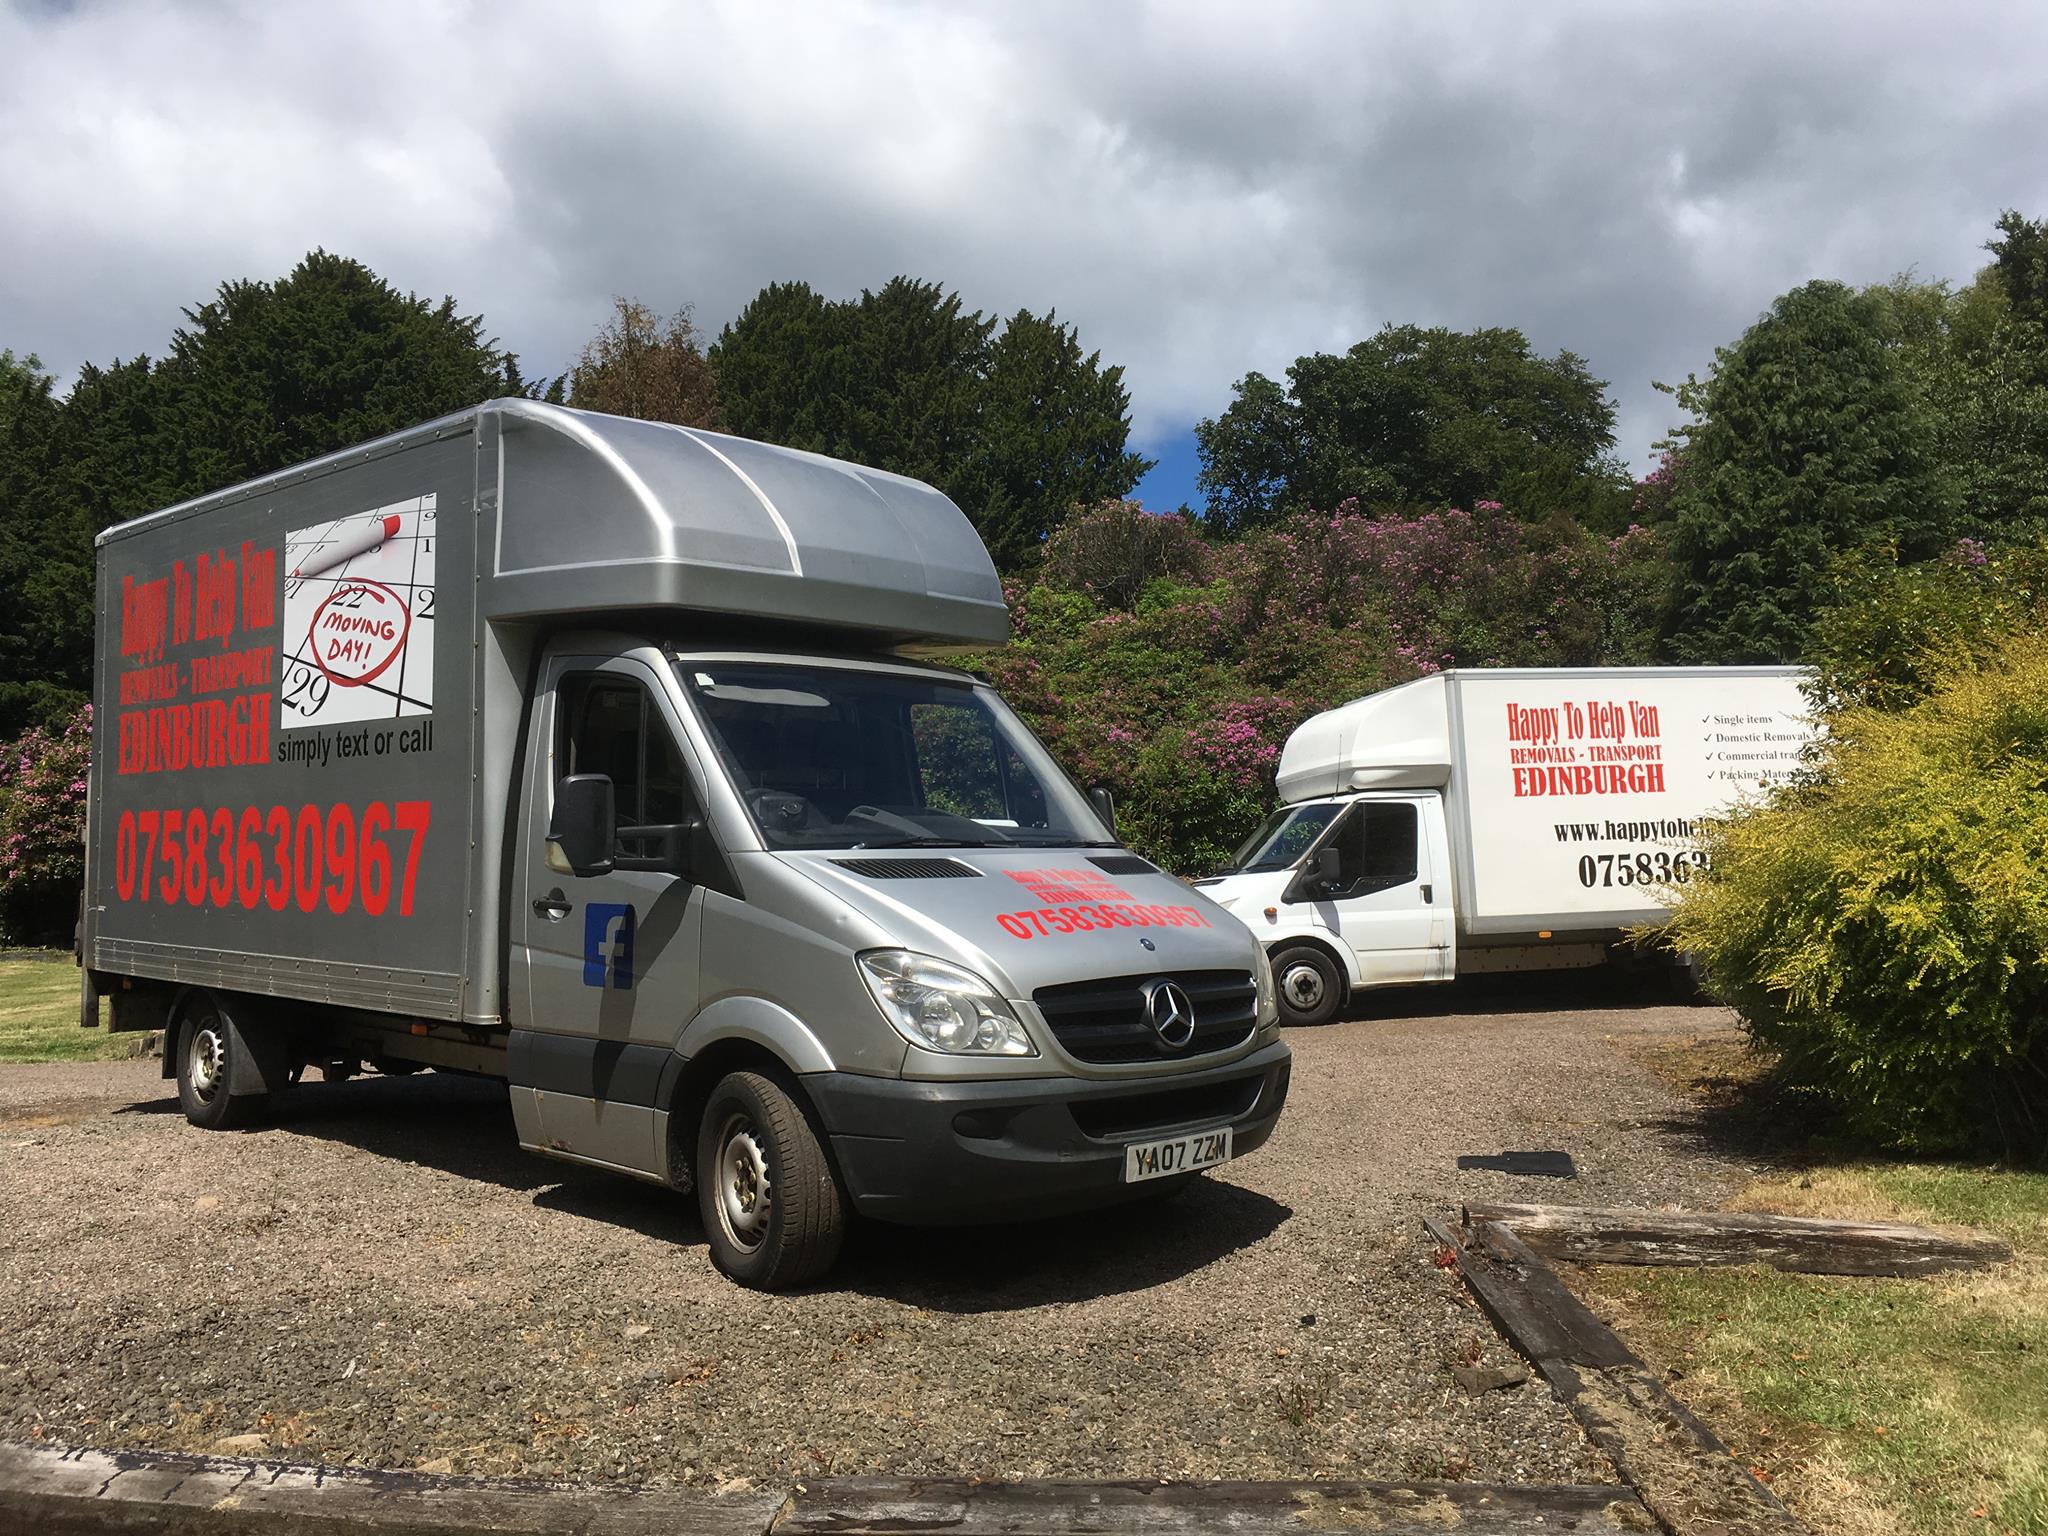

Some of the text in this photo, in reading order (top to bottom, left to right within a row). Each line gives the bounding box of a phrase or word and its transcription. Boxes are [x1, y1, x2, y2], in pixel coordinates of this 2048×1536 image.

[121, 540, 274, 665] Happy To Help Van
[331, 584, 367, 609] 22
[323, 611, 395, 641] MOVING
[327, 638, 372, 670] DAY!
[119, 662, 178, 706] REMOVALS
[191, 645, 273, 695] TRANSPORT
[282, 667, 331, 717] 29
[118, 692, 272, 776] EDINBURGH
[1507, 700, 1660, 746] Happy To Help Van
[1714, 714, 1773, 726] Single items
[278, 720, 433, 768] simply text or call
[1510, 747, 1576, 764] REMOVALS
[1588, 745, 1662, 762] TRANSPORT
[1716, 732, 1811, 743] Domestic Removals
[1717, 751, 1778, 761] Commercial
[1512, 763, 1666, 797] EDINBURGH
[1719, 769, 1759, 781] Packing
[116, 800, 431, 917] 07583630967
[996, 905, 1213, 940] 07583630967
[1136, 1133, 1227, 1176] YA07 ZZM
